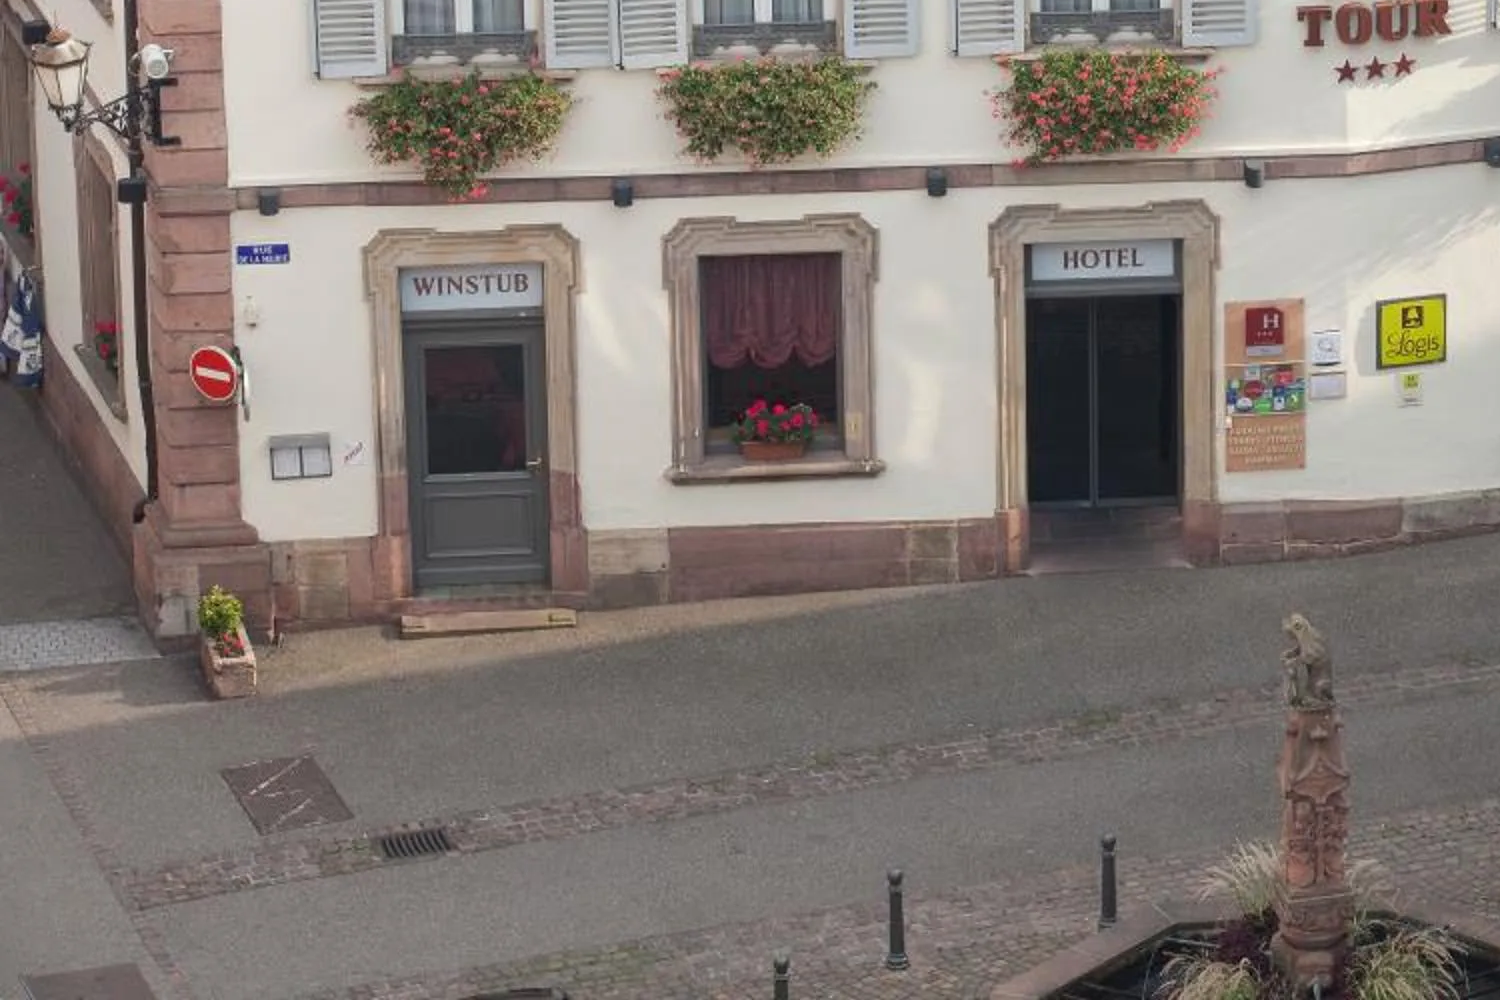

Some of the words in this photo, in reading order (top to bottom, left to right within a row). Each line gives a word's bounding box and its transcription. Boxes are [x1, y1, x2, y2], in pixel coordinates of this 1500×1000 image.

[1062, 247, 1145, 270] HOTEL
[412, 272, 529, 297] WINSTUB
[1263, 312, 1279, 329] H
[1385, 329, 1440, 358] Logis
